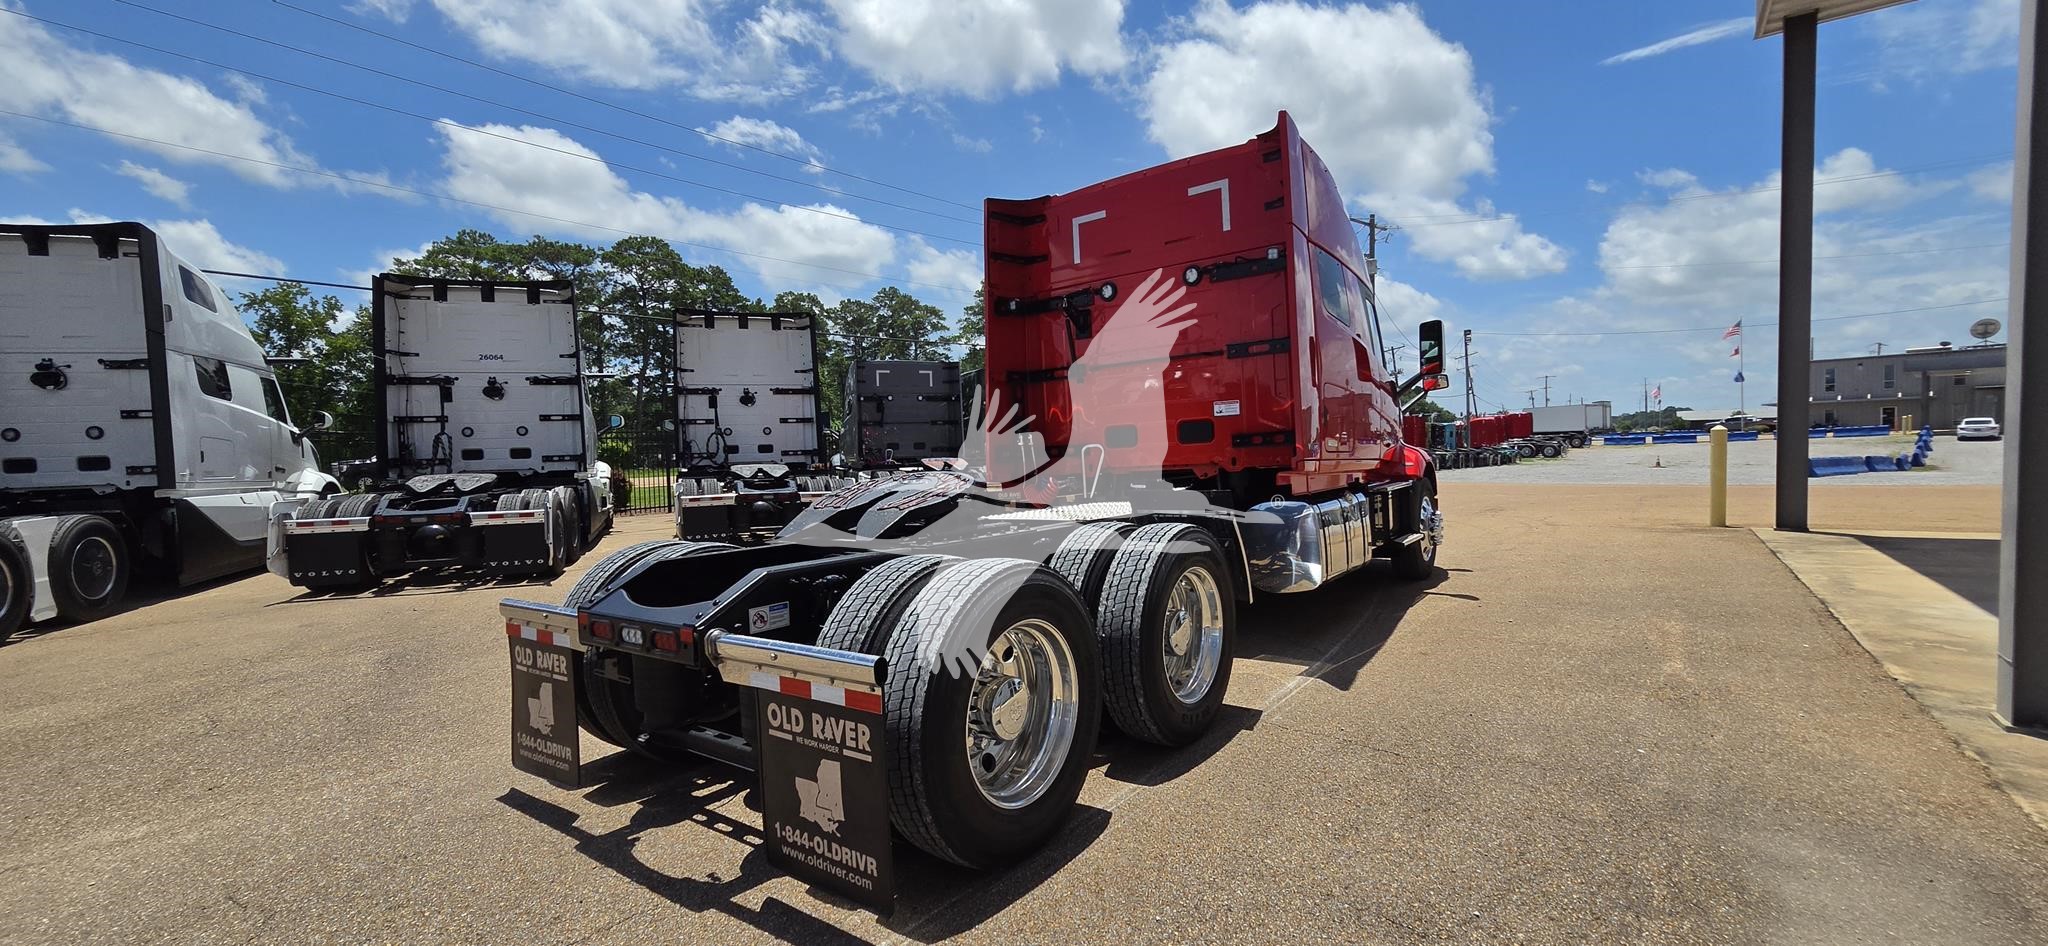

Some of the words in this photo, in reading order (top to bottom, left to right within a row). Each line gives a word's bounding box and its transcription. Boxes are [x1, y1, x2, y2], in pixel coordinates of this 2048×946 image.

[479, 353, 504, 361] 26064
[686, 532, 727, 540] VOLVO
[293, 568, 357, 578] VOLVO
[489, 558, 545, 567] VOLVO
[514, 644, 533, 667] OLD
[536, 650, 568, 675] RIVER
[767, 702, 805, 734] OLD
[811, 712, 872, 753] RIVER
[516, 731, 573, 762] 1-844-OLDRIVR
[795, 735, 804, 745] WE
[804, 738, 819, 749] WORK
[818, 742, 840, 755] HARDER
[774, 821, 878, 877] 1-844-OLDRIVR
[781, 844, 873, 891] www.oldriver.com
